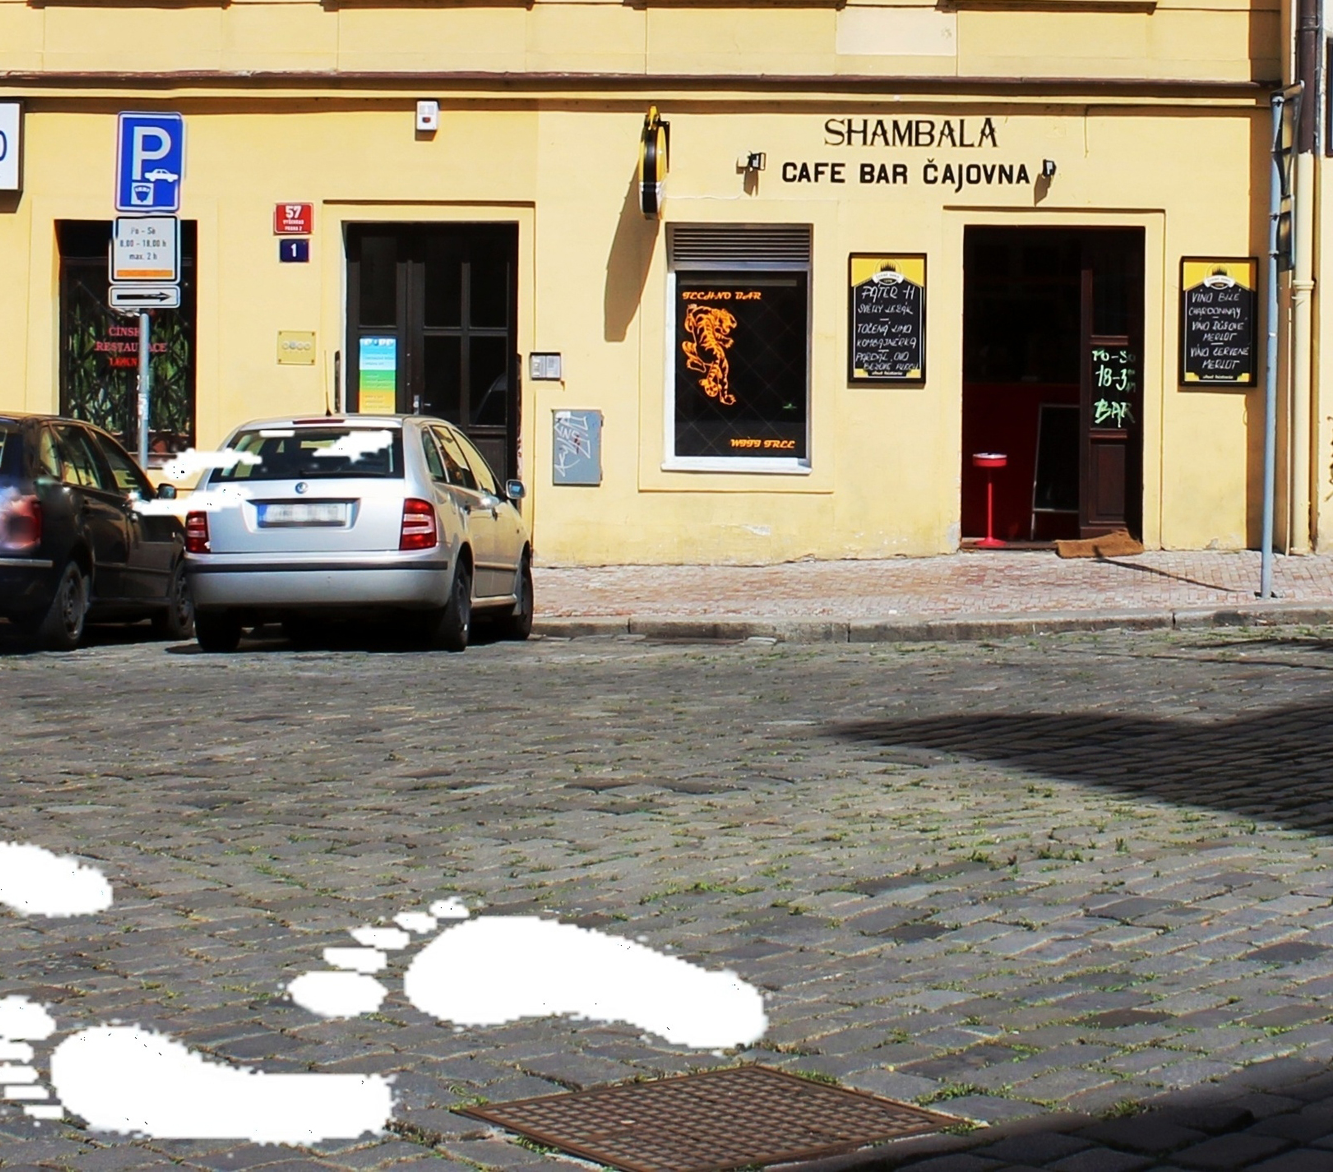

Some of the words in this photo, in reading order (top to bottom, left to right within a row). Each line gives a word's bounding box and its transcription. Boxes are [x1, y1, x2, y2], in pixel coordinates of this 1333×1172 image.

[823, 116, 999, 148] SHAMBALA
[131, 126, 172, 181] P
[782, 161, 846, 184] CAFE
[859, 163, 909, 185] BAR
[922, 157, 1031, 194] ČAJOVNA
[285, 205, 302, 219] 57
[290, 243, 297, 258] 1
[681, 290, 733, 301] TECHNO
[734, 291, 762, 301] BAR
